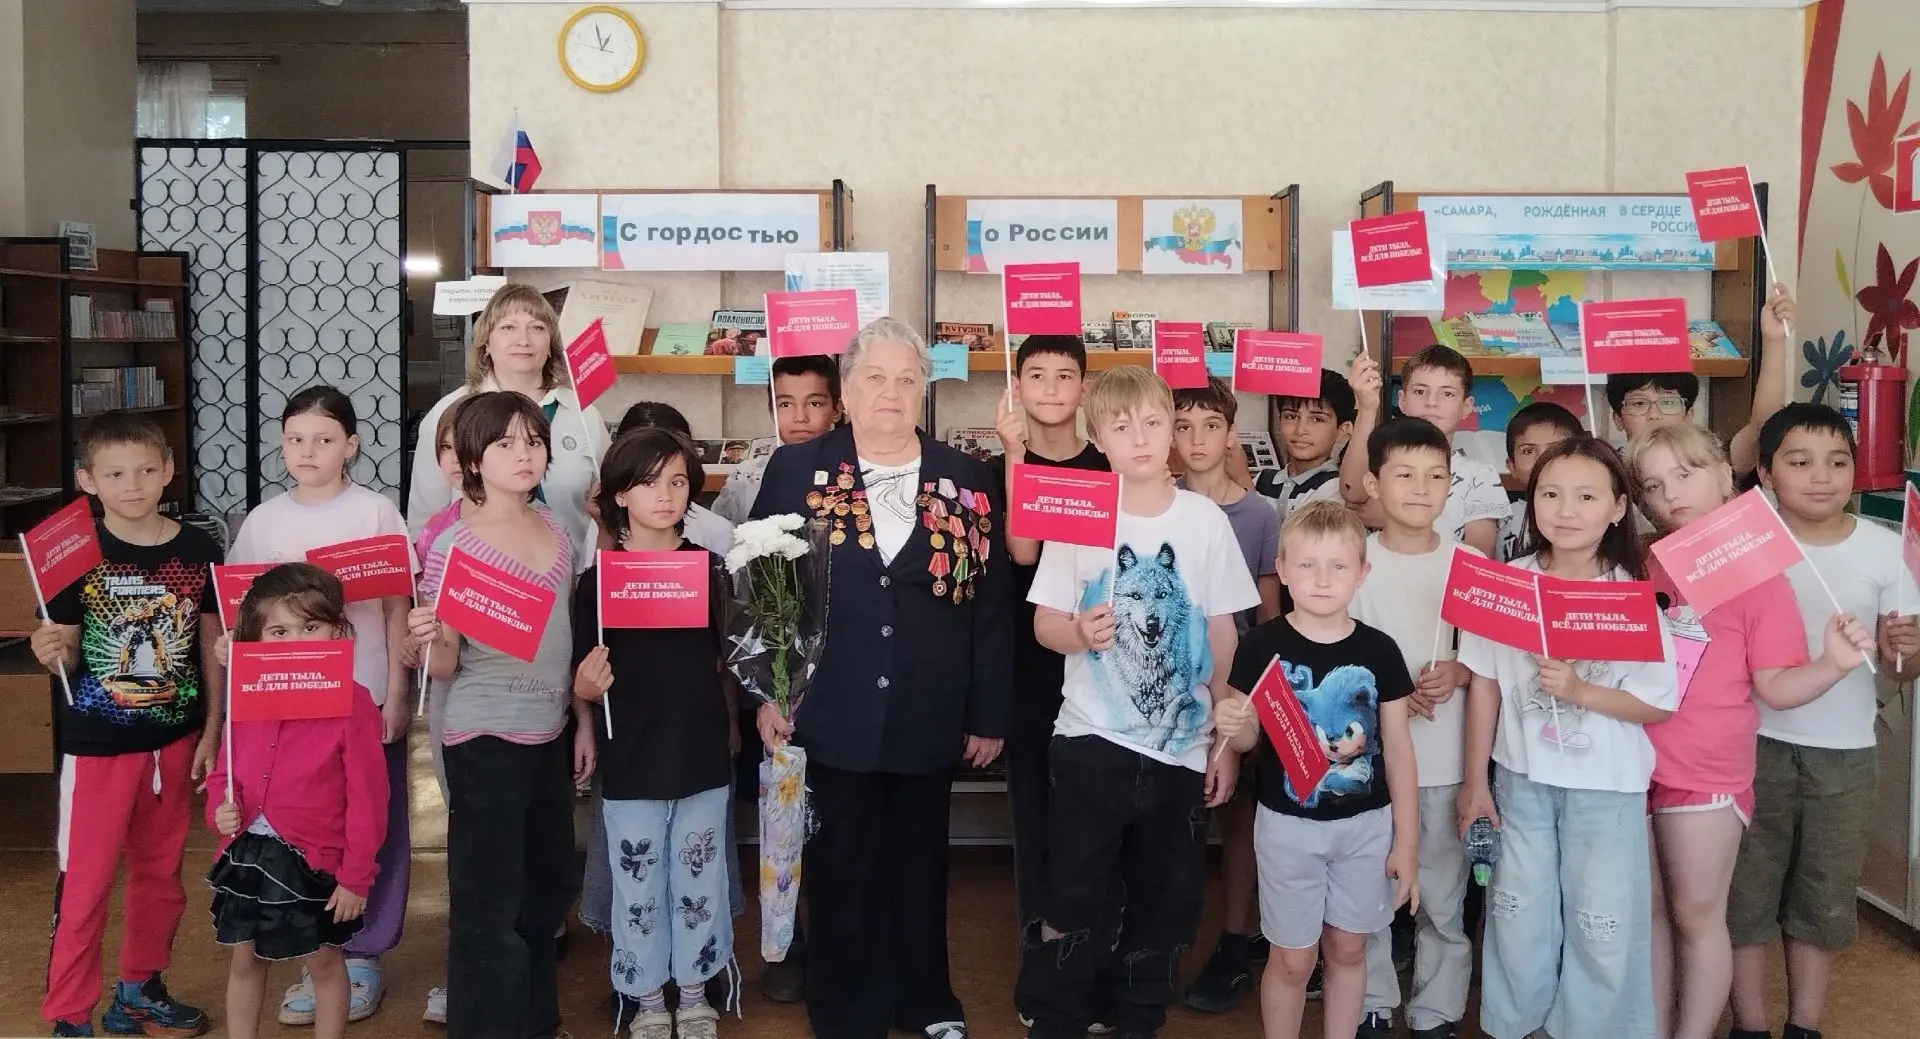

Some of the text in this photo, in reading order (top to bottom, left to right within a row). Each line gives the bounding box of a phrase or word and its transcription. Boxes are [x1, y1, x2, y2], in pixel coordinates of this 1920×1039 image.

[1524, 205, 1606, 219] РОЖДЁННАЯ
[1619, 205, 1627, 216] В
[1631, 205, 1682, 218] СЕРДЦЕ
[620, 222, 637, 241] С
[985, 224, 1108, 242] о России
[1251, 355, 1275, 364] ДЕТИ
[1035, 495, 1062, 505] ДЕТИ
[1022, 502, 1109, 519] ВСЁ ДЛЯ ПОБЕДЫ!
[1695, 547, 1722, 567] ДЕТИ
[334, 564, 360, 577] ДЕТИ
[1706, 557, 1728, 573] ДЛЯ
[341, 566, 406, 582] ДЛЯ ПОБЕДЫ!
[103, 575, 144, 590] TRANS
[623, 582, 650, 590] ДЕТИ
[109, 585, 166, 600] FORMERS
[463, 587, 488, 605] ДЕТИ
[610, 589, 698, 600] ВСЁ ДЛЯ ПОБЕДЫ!
[1452, 588, 1472, 602] ВСЁ
[1472, 596, 1495, 610] ДЛЯ
[1468, 585, 1496, 601] ДЕТИ
[448, 587, 532, 633] ВСЁ ДЛЯ ПОБЕДЫ!
[1565, 612, 1593, 621] ДЕТИ
[1551, 620, 1648, 632] ВСЁ ДЛЯ ПОБЕДЫ!
[259, 672, 289, 682] ДЕТИ
[241, 681, 341, 692] ВСЁ ДЛЯ ПОБЕДЫ!
